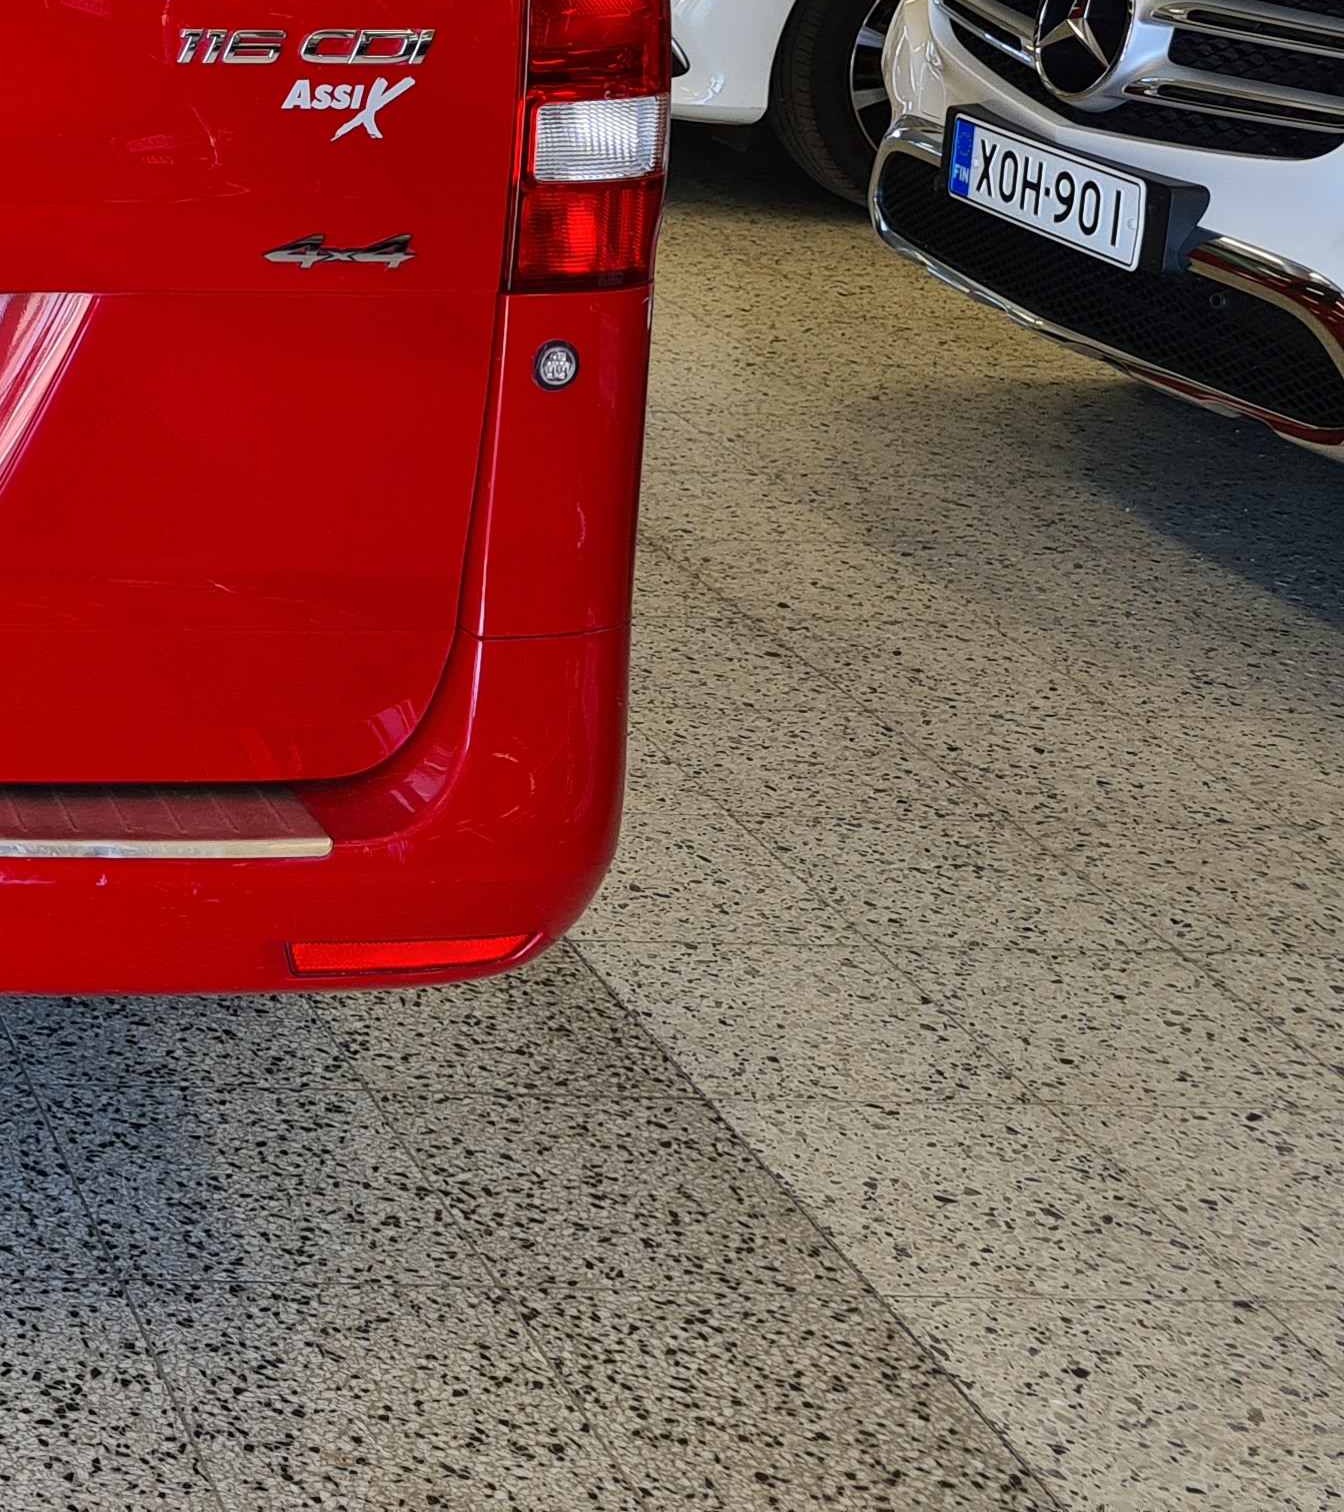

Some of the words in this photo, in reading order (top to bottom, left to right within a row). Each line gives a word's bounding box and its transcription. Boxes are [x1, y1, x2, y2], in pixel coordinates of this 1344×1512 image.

[176, 28, 287, 64] 116
[299, 28, 436, 64] CDI
[952, 163, 971, 184] FIN
[975, 138, 1123, 248] XOH-901
